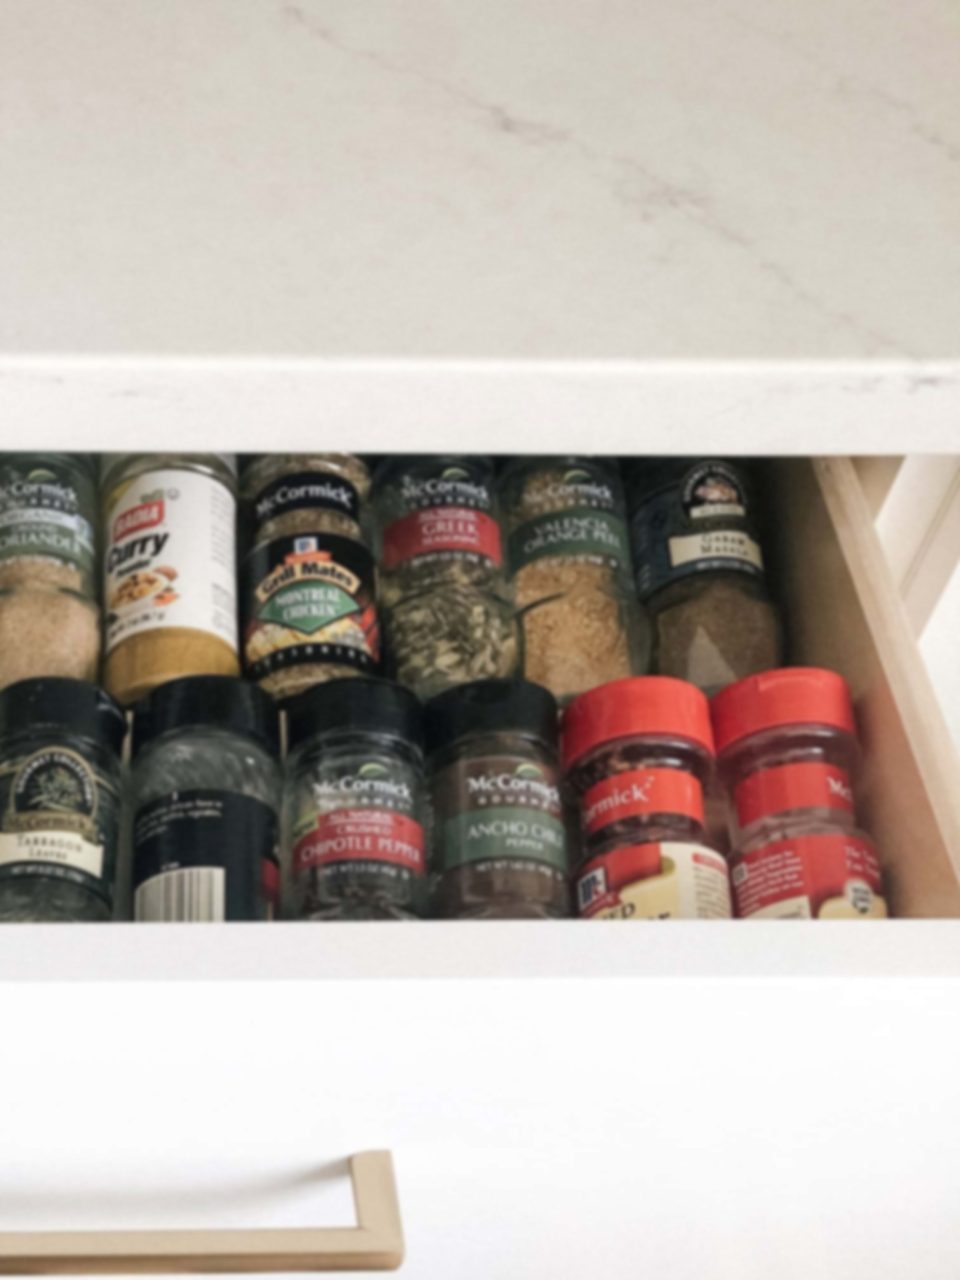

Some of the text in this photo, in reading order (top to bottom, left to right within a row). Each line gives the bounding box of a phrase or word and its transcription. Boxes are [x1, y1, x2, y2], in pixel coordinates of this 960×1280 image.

[256, 482, 353, 518] McCormick
[301, 561, 354, 586] Mates
[467, 773, 561, 803] McCormick
[468, 820, 529, 840] ANCHO
[301, 836, 373, 862] CHIPOTLE
